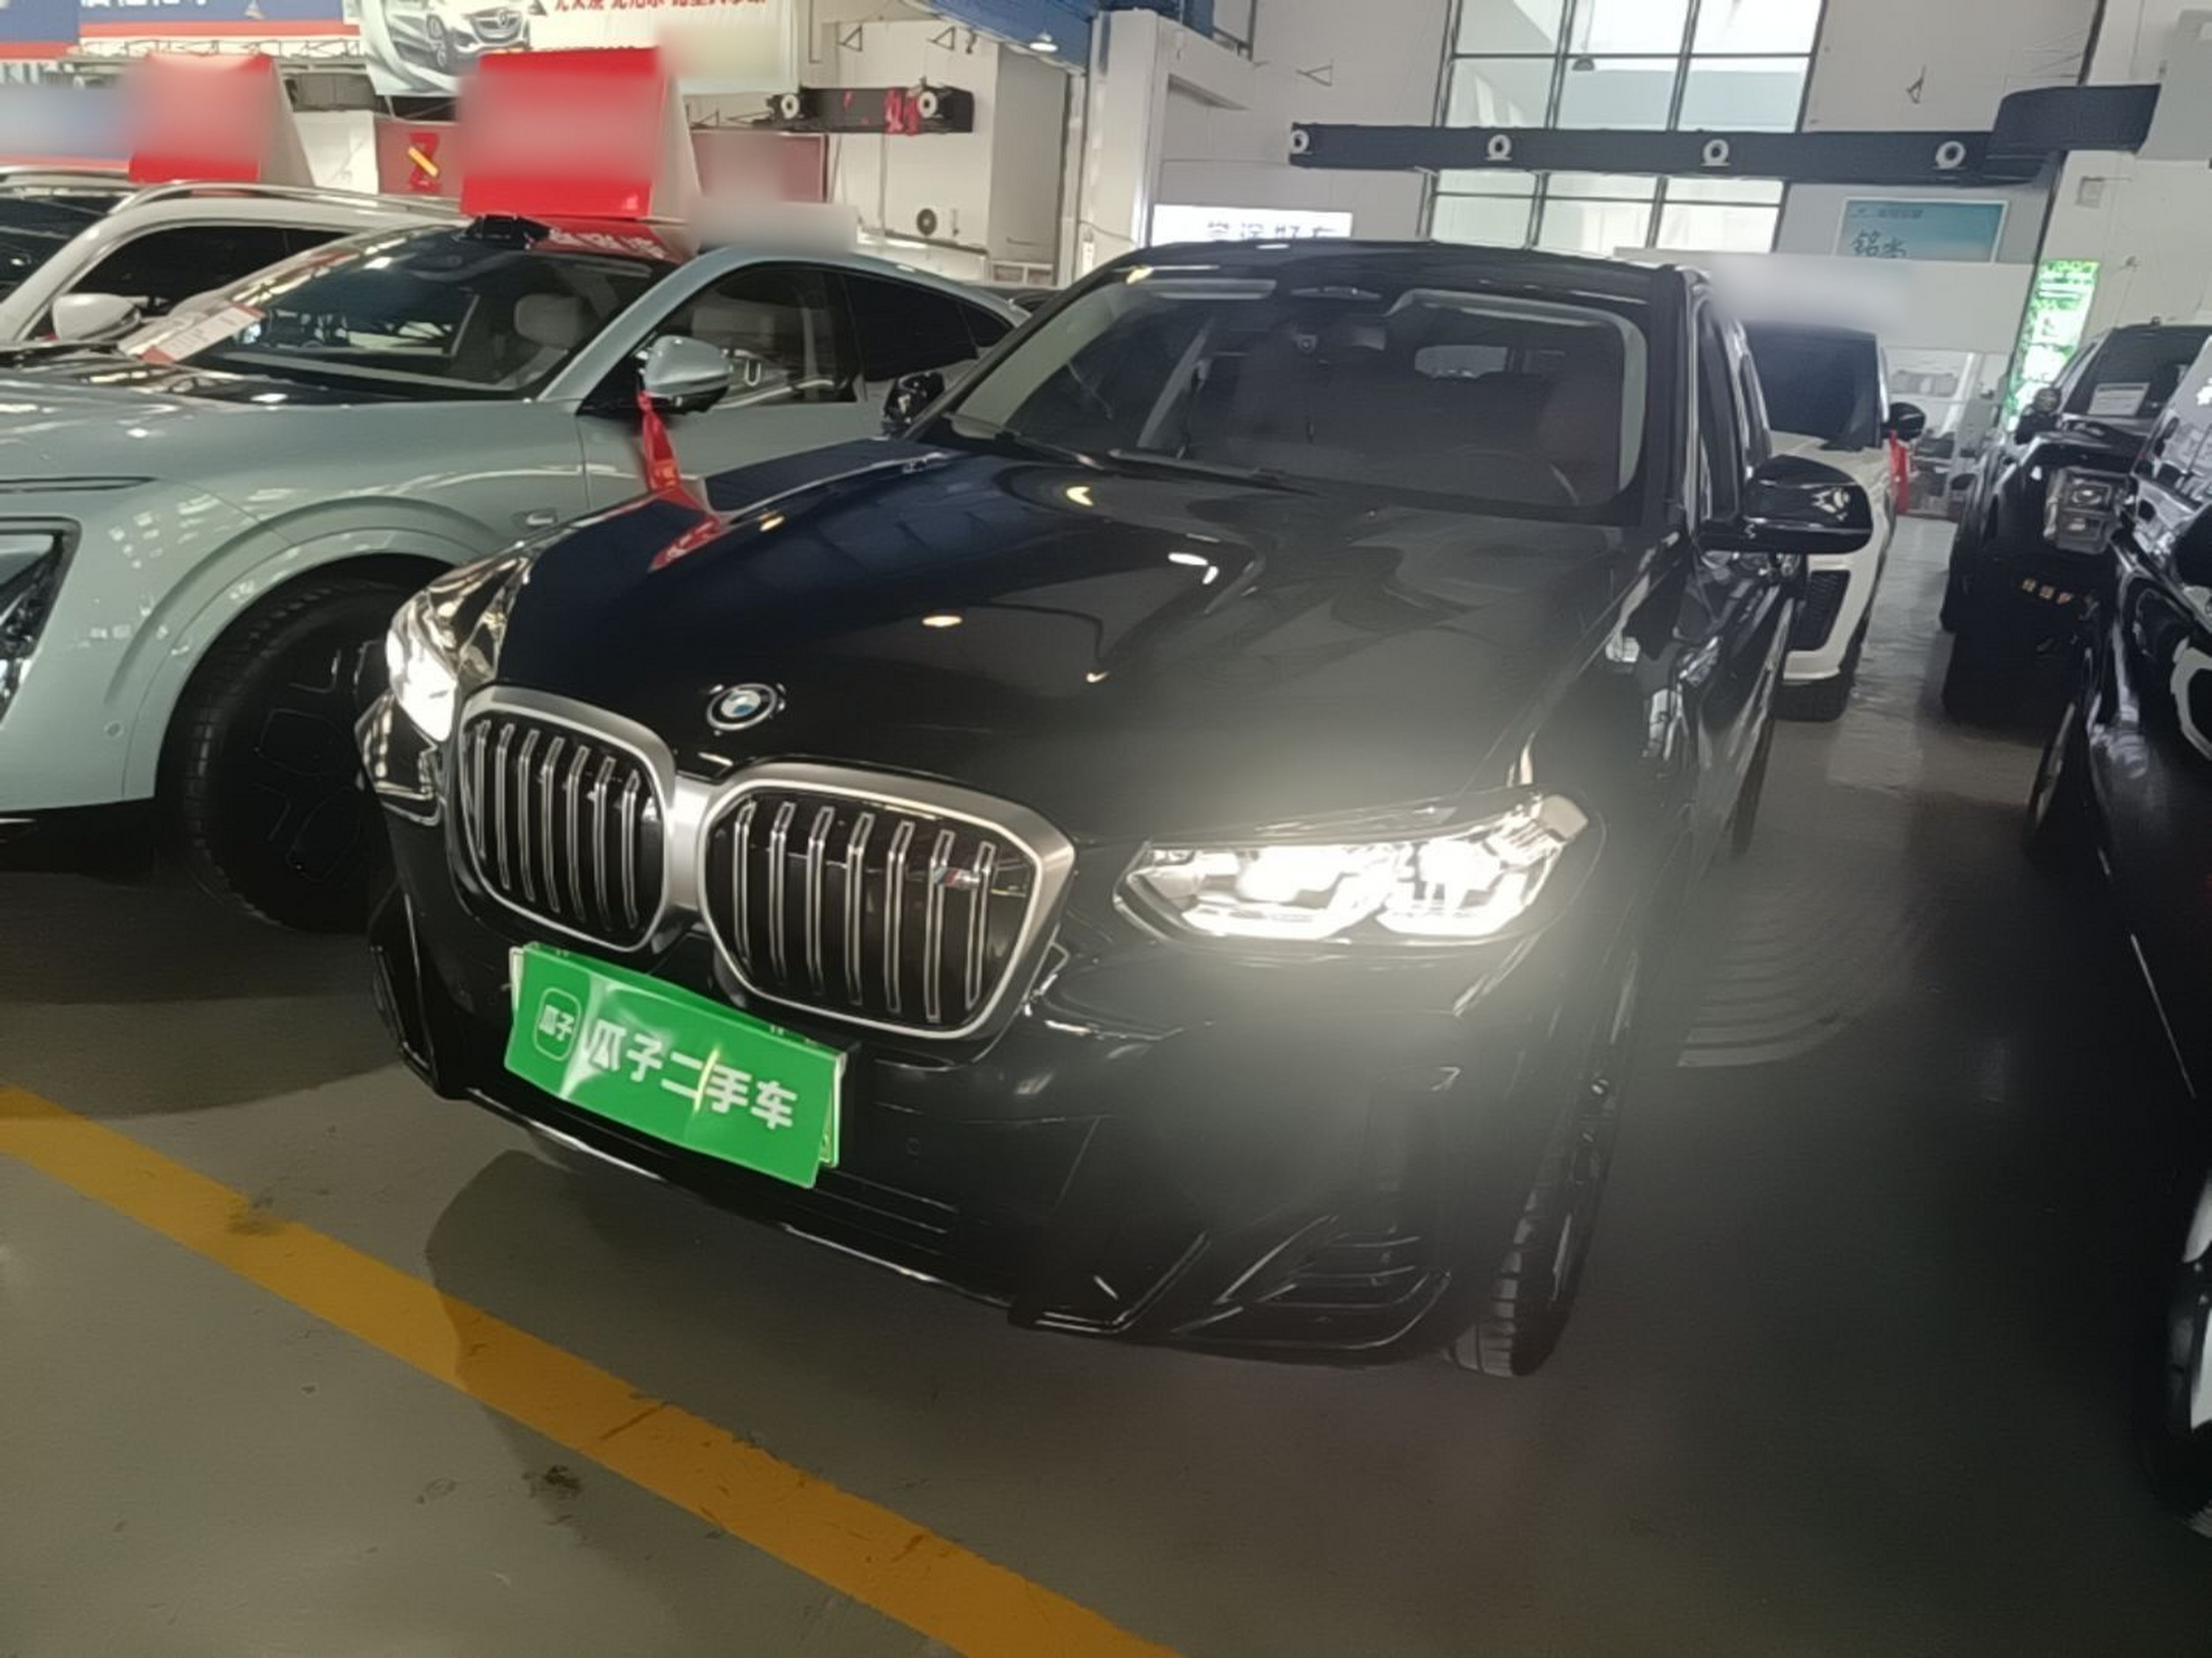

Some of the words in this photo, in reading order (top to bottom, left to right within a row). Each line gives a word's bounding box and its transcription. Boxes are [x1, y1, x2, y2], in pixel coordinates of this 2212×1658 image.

[539, 1004, 575, 1042] 瓜子
[586, 1018, 798, 1130] 瓜子二手车
